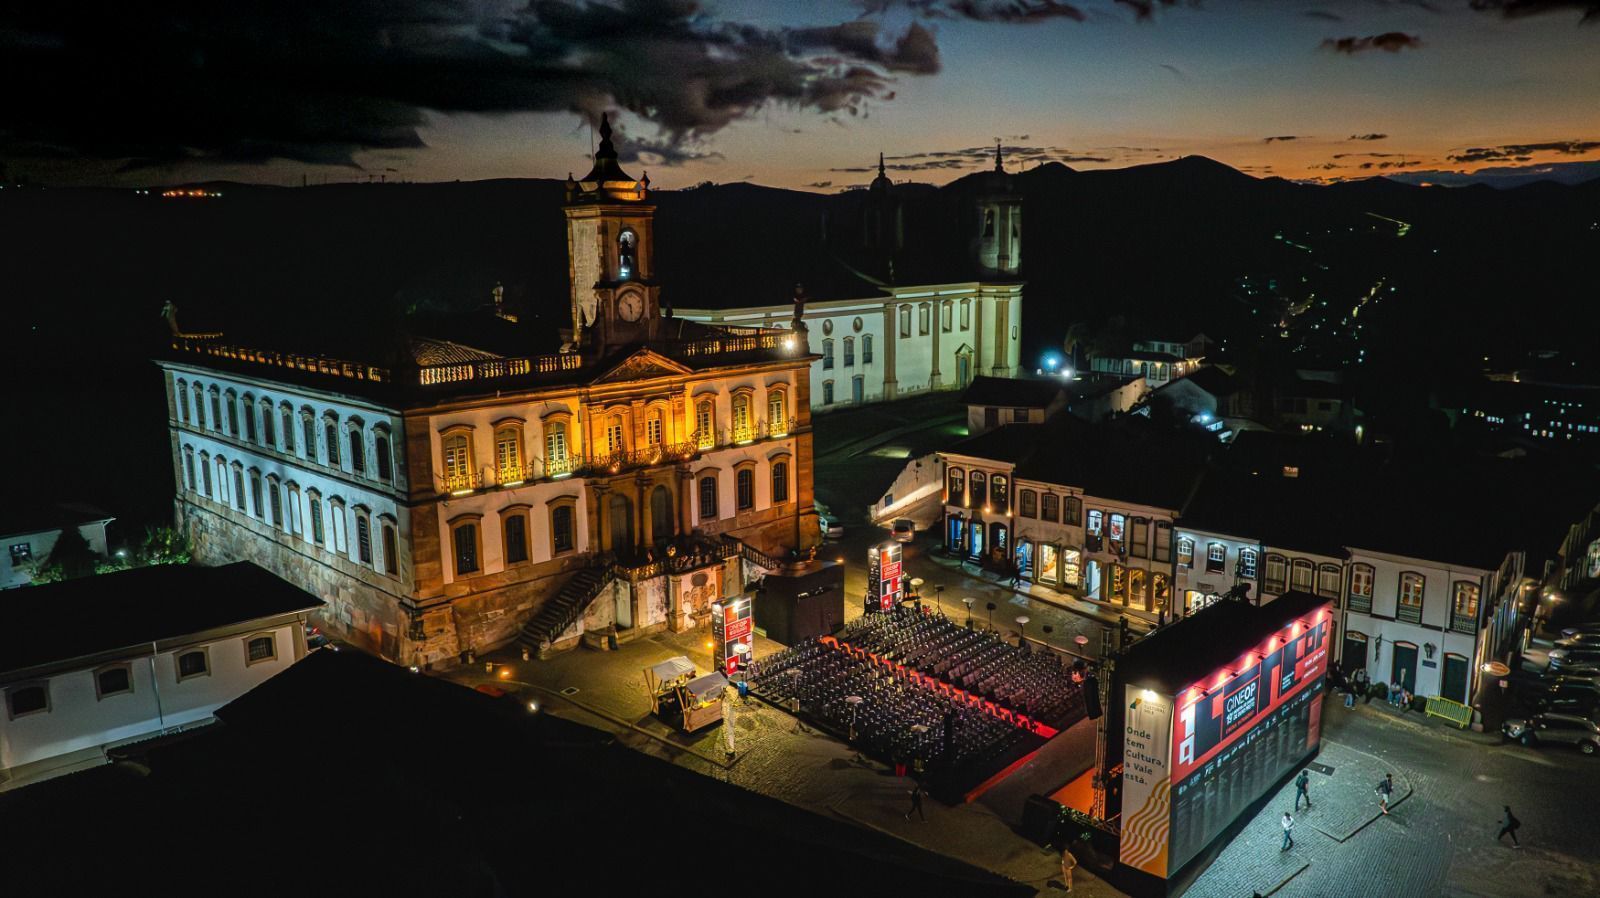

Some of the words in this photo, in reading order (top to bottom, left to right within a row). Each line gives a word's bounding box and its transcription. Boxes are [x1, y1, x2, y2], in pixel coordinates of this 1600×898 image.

[1227, 682, 1256, 712] CINEOP
[1126, 726, 1151, 740] Onde
[1126, 737, 1145, 750] tem
[1133, 762, 1153, 775] Vale
